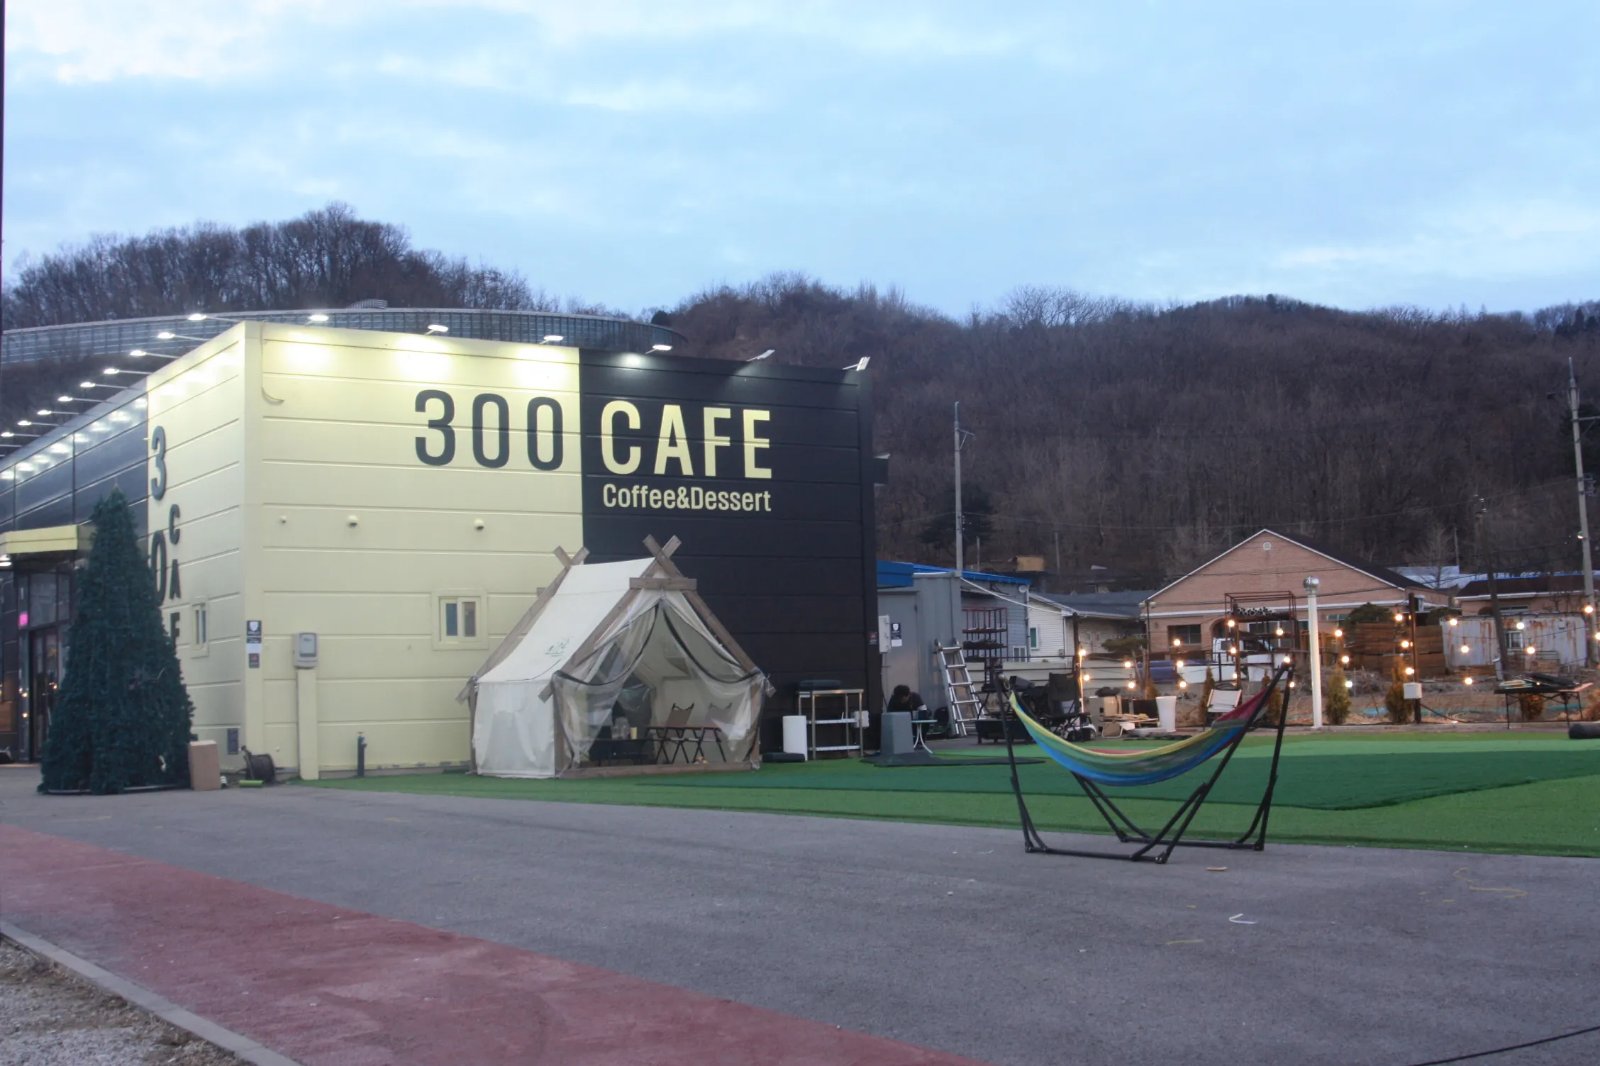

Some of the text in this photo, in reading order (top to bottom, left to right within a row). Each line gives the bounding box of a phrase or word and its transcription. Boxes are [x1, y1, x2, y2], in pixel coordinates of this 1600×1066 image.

[415, 389, 772, 479] 300 CAFE
[603, 483, 772, 512] Coffee&Dessert
